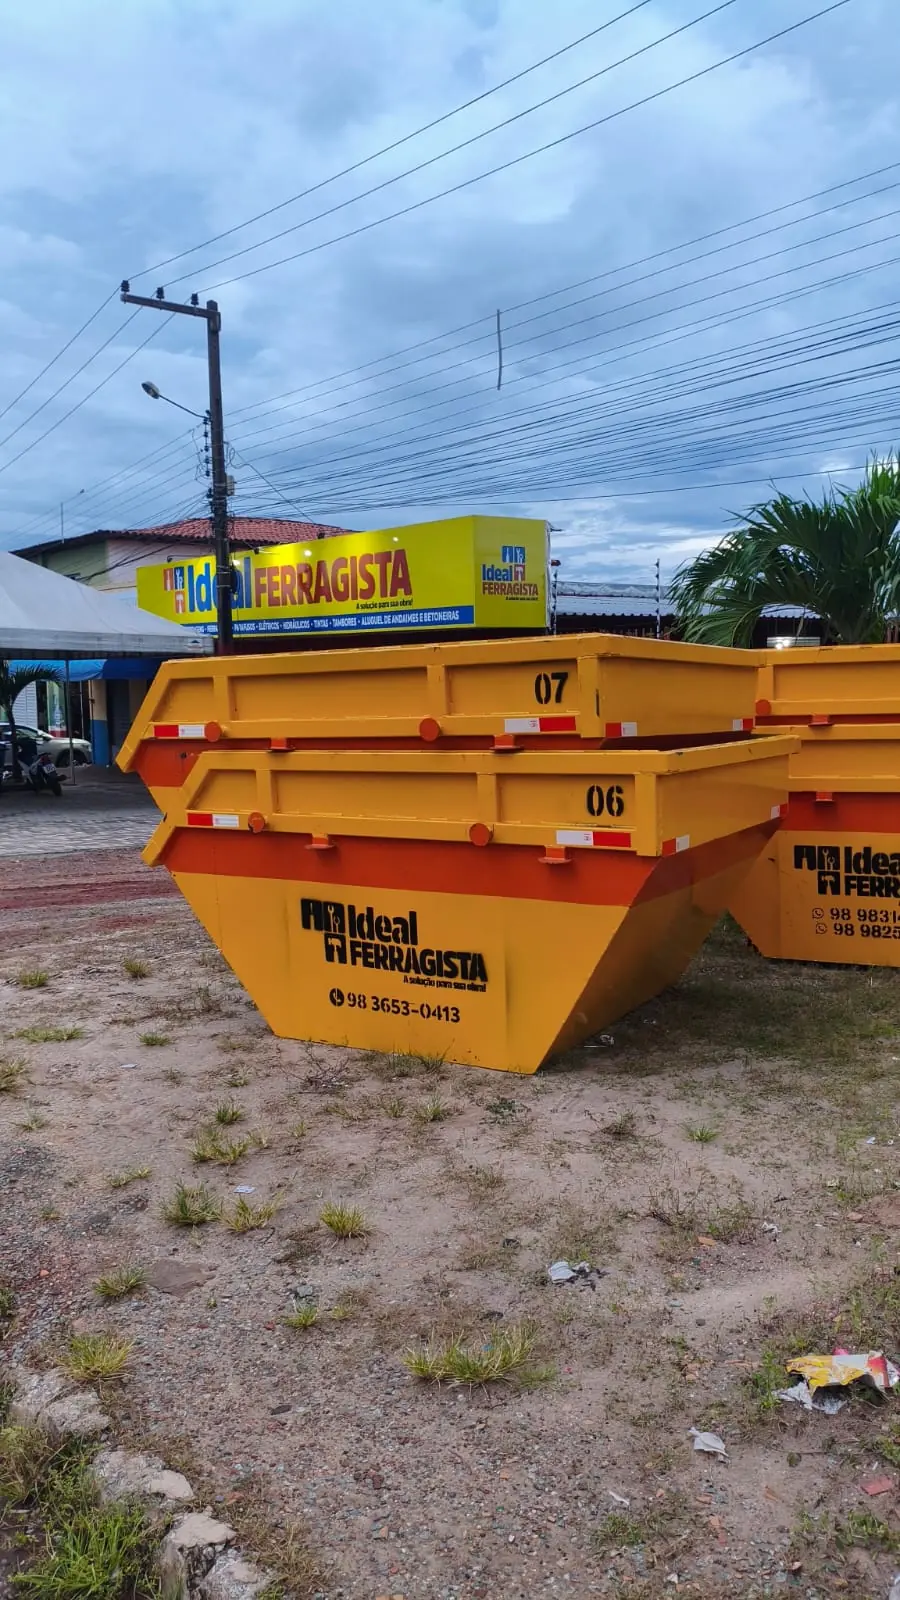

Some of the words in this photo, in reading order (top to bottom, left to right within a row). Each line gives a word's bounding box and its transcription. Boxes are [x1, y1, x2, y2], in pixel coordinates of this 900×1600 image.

[187, 557, 252, 613] Idal
[254, 549, 413, 608] FERRAGISTA
[482, 564, 513, 582] Ideal
[482, 582, 539, 597] FERRAGISTA
[313, 619, 329, 628] TINTAS
[332, 617, 357, 627] TAMBORES
[361, 615, 384, 626] ALUGUEL
[384, 615, 392, 624] DE
[392, 613, 418, 624] ANDAIMES
[420, 613, 423, 622] E
[424, 610, 459, 622] BETONEIRAS
[534, 671, 569, 705] 07
[586, 785, 625, 817] 06
[844, 875, 900, 898] FERR
[347, 904, 419, 946] Ideal
[829, 907, 851, 921] 98
[857, 908, 900, 923] 9831
[834, 923, 855, 937] 98
[349, 940, 489, 982] FERRAGISTA
[403, 975, 408, 983] A
[347, 991, 367, 1009] 98
[371, 995, 461, 1023] 3653-0413
